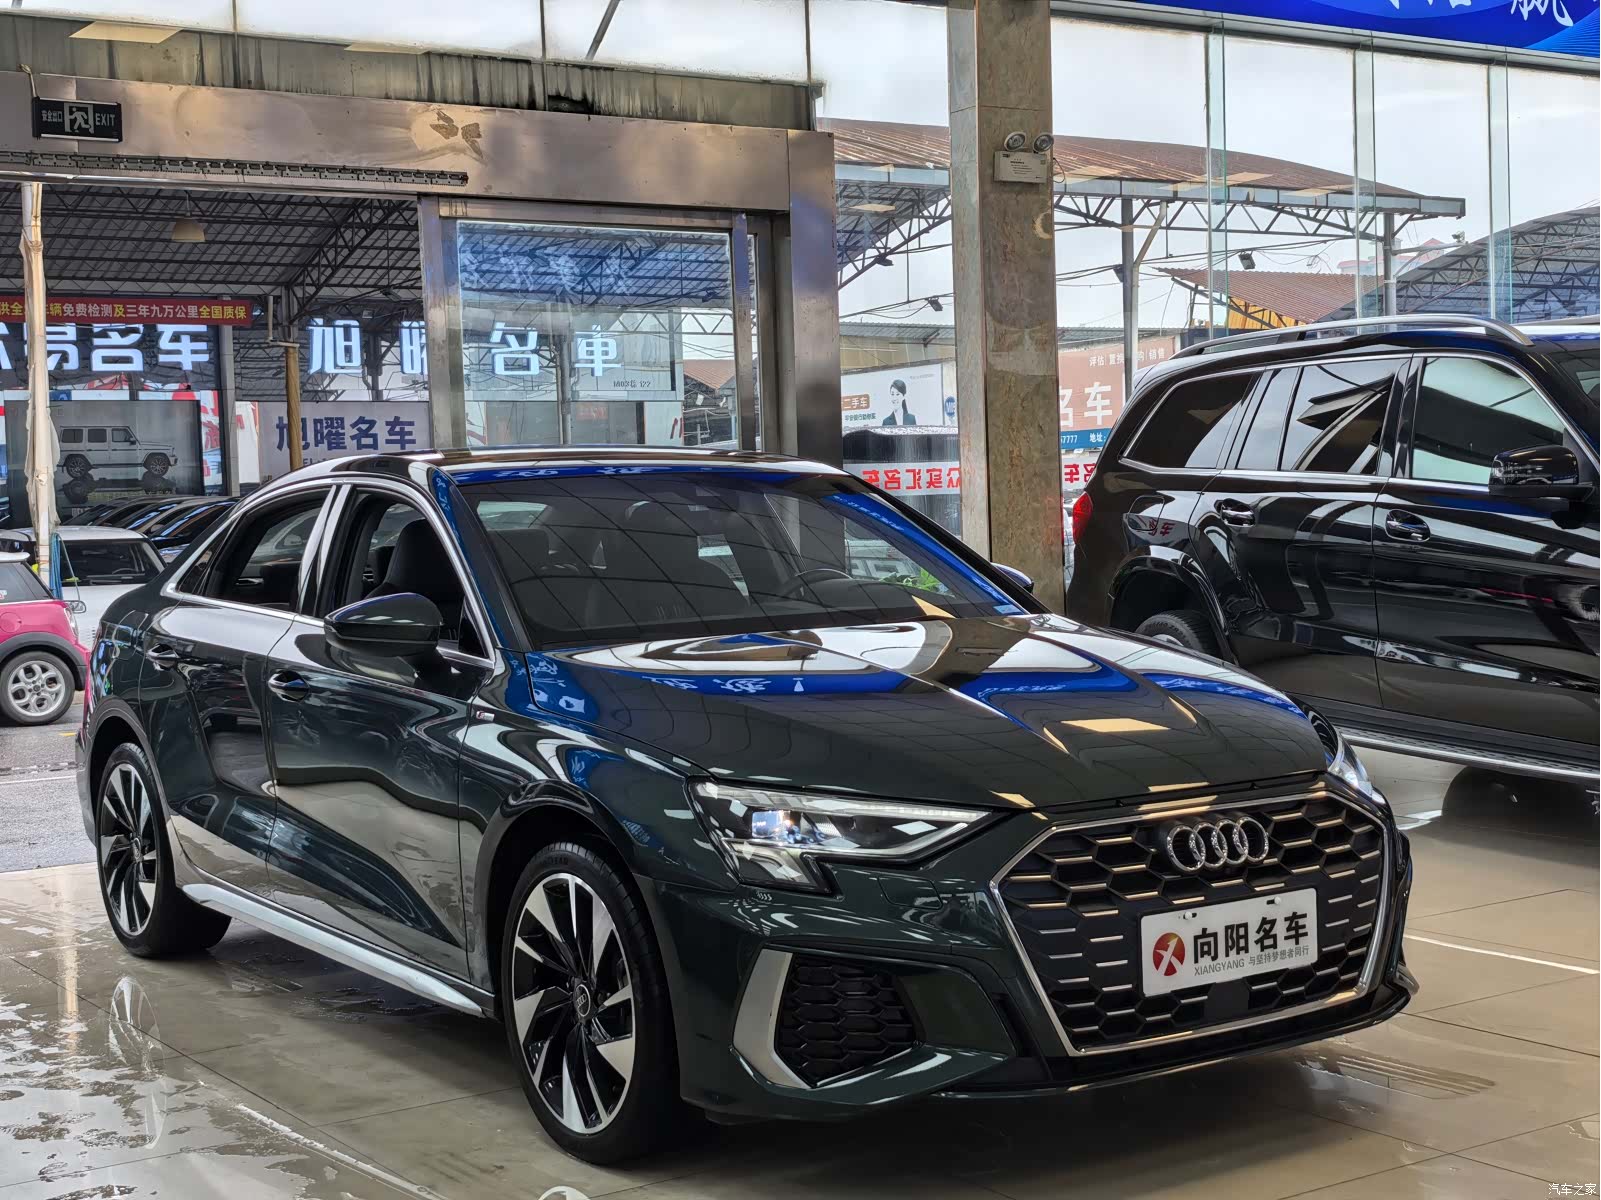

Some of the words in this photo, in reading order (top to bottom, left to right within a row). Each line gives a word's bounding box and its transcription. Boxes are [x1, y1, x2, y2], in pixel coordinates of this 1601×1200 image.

[41, 109, 63, 122] 安全出口
[95, 112, 115, 126] EXIT
[1193, 911, 1309, 964] 向阳名车
[1194, 958, 1245, 976] XIANGYANG
[1248, 945, 1310, 967] 与坚持梦想者同行
